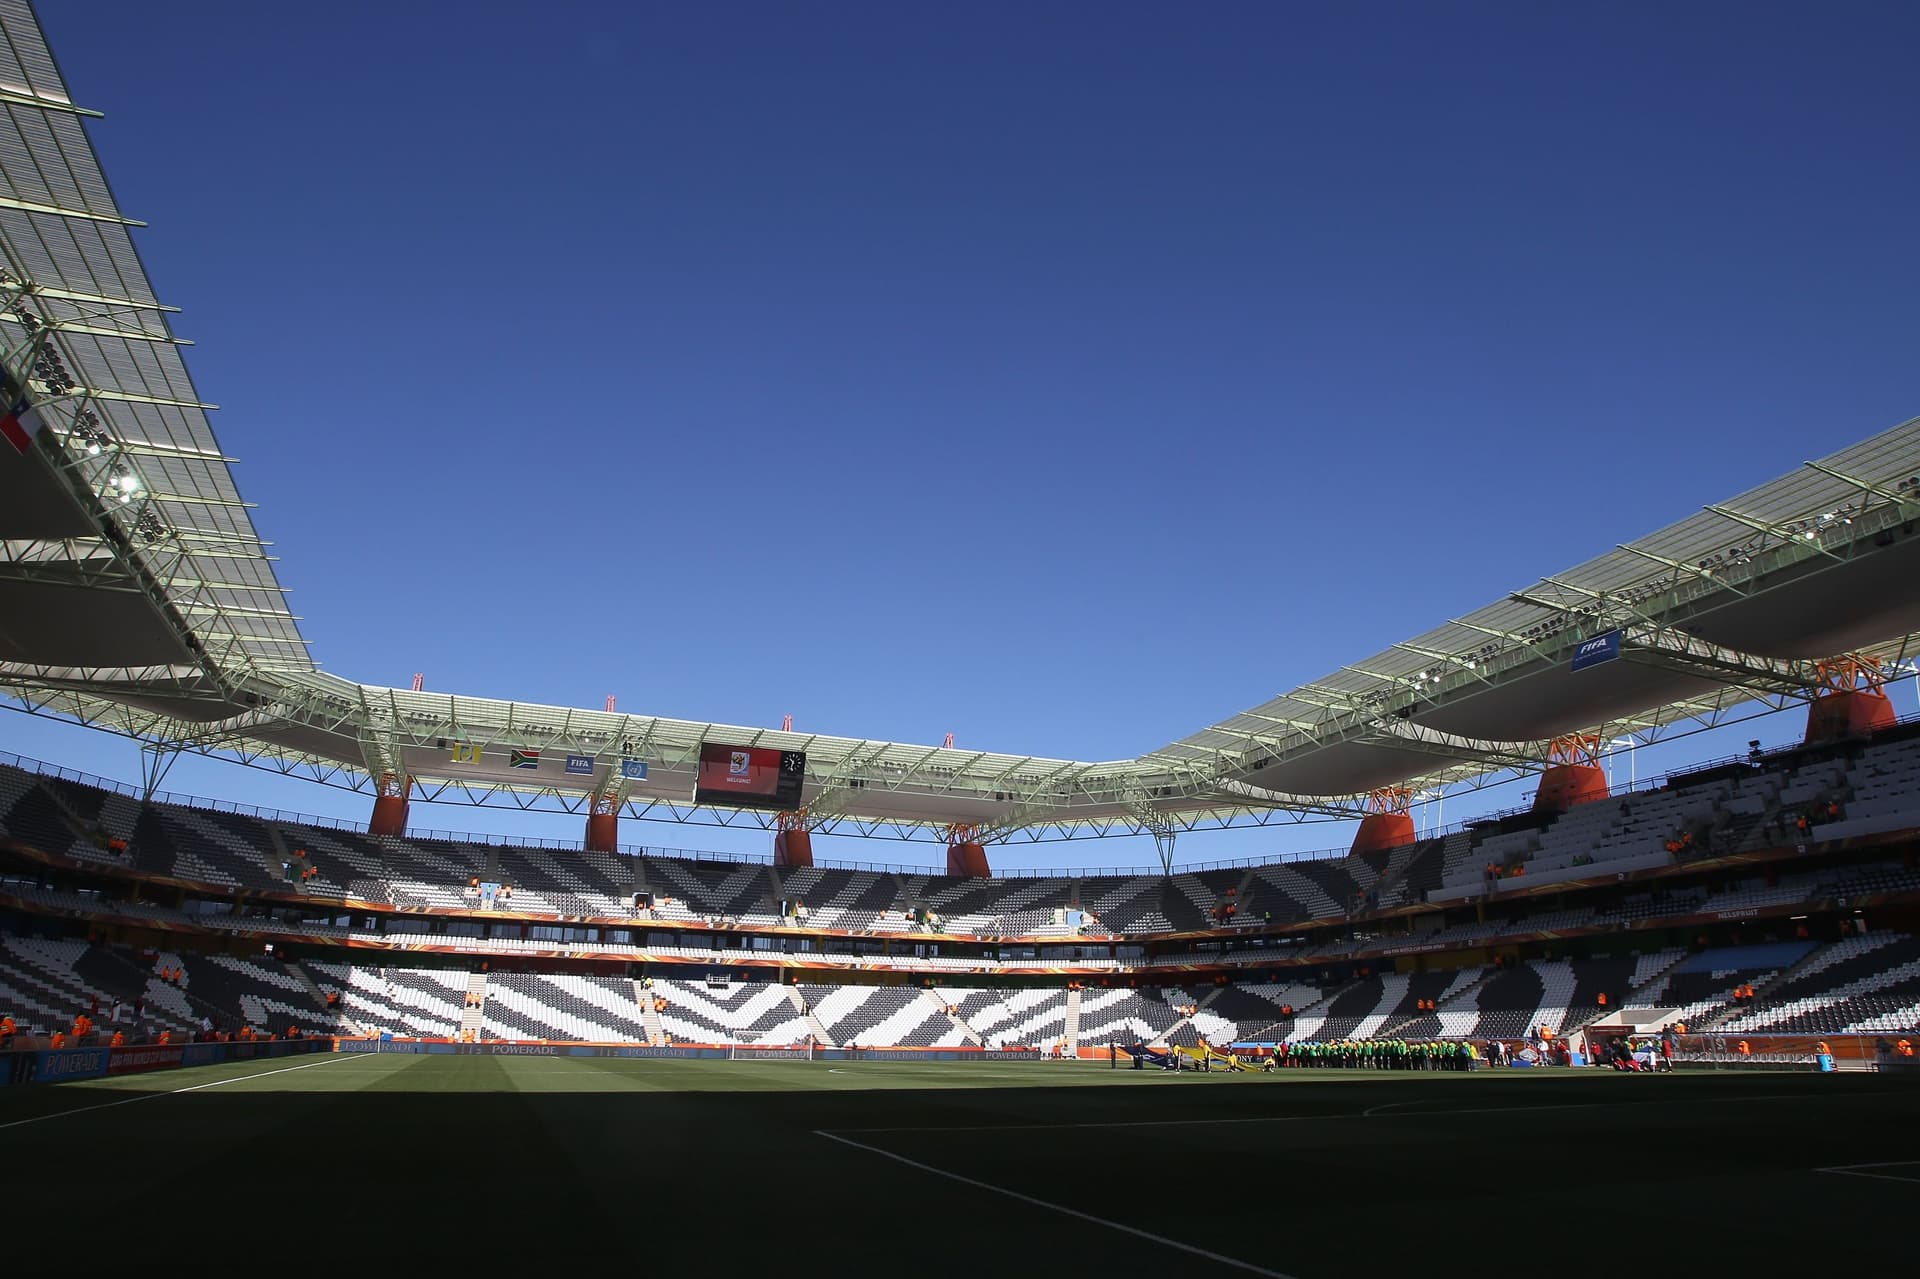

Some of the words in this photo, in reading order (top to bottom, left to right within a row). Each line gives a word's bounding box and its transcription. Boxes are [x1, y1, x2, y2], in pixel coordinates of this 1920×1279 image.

[1580, 638, 1607, 654] FIFA
[571, 759, 589, 767] FIFA
[492, 1045, 558, 1055] POWERADE
[628, 1047, 686, 1057] POWERADE
[875, 1051, 927, 1060] POWERADE
[986, 1051, 1035, 1060] POWERADE
[1237, 1055, 1253, 1063] ONY
[46, 1053, 103, 1075] POWERADE
